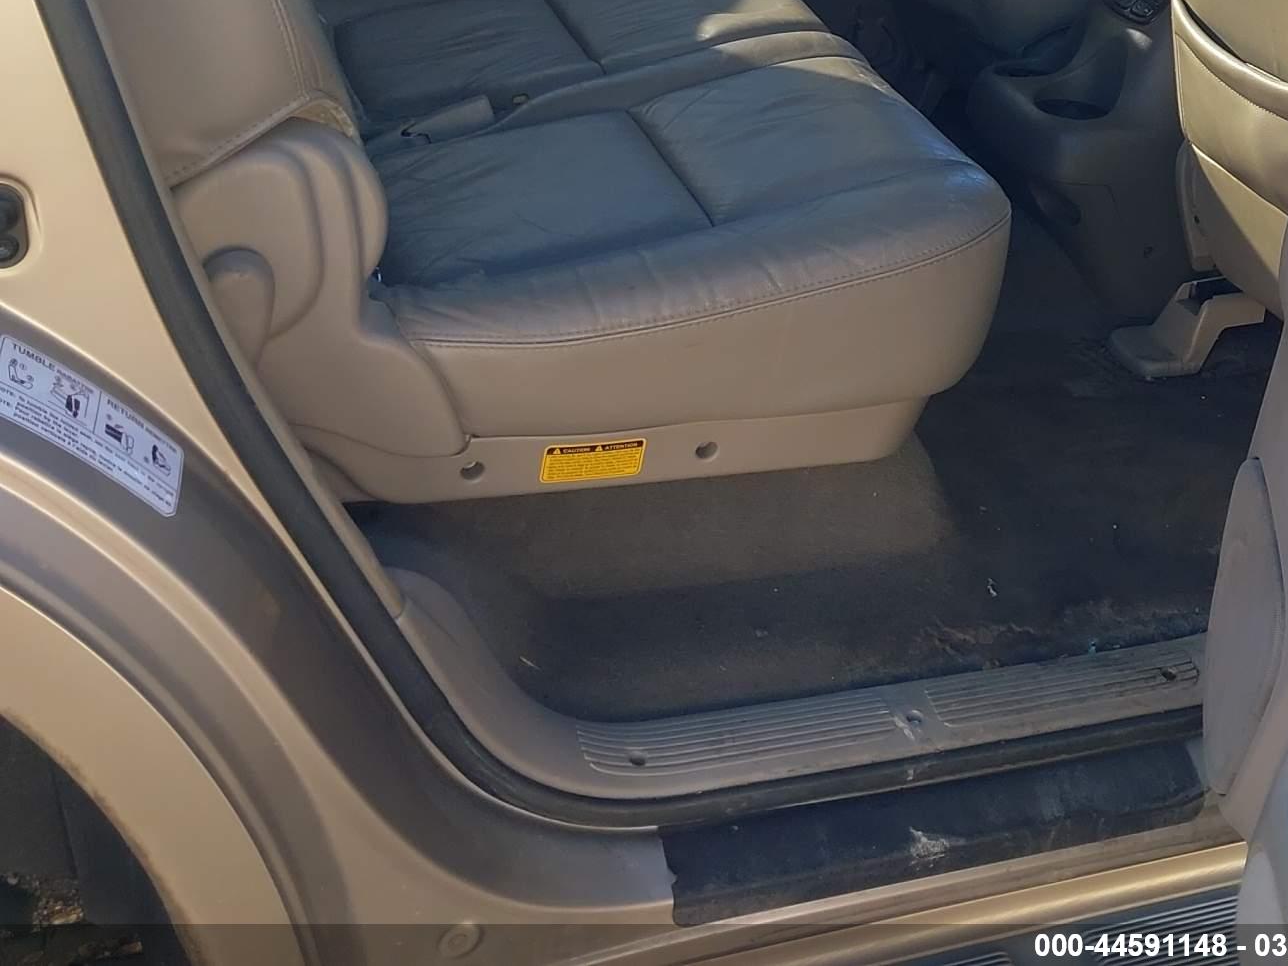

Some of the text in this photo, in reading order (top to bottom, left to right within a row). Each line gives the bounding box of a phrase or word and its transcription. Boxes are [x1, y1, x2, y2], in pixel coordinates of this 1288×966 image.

[13, 343, 56, 372] TUMBLE
[107, 399, 145, 430] RETURN
[604, 442, 638, 451] ATTENTION
